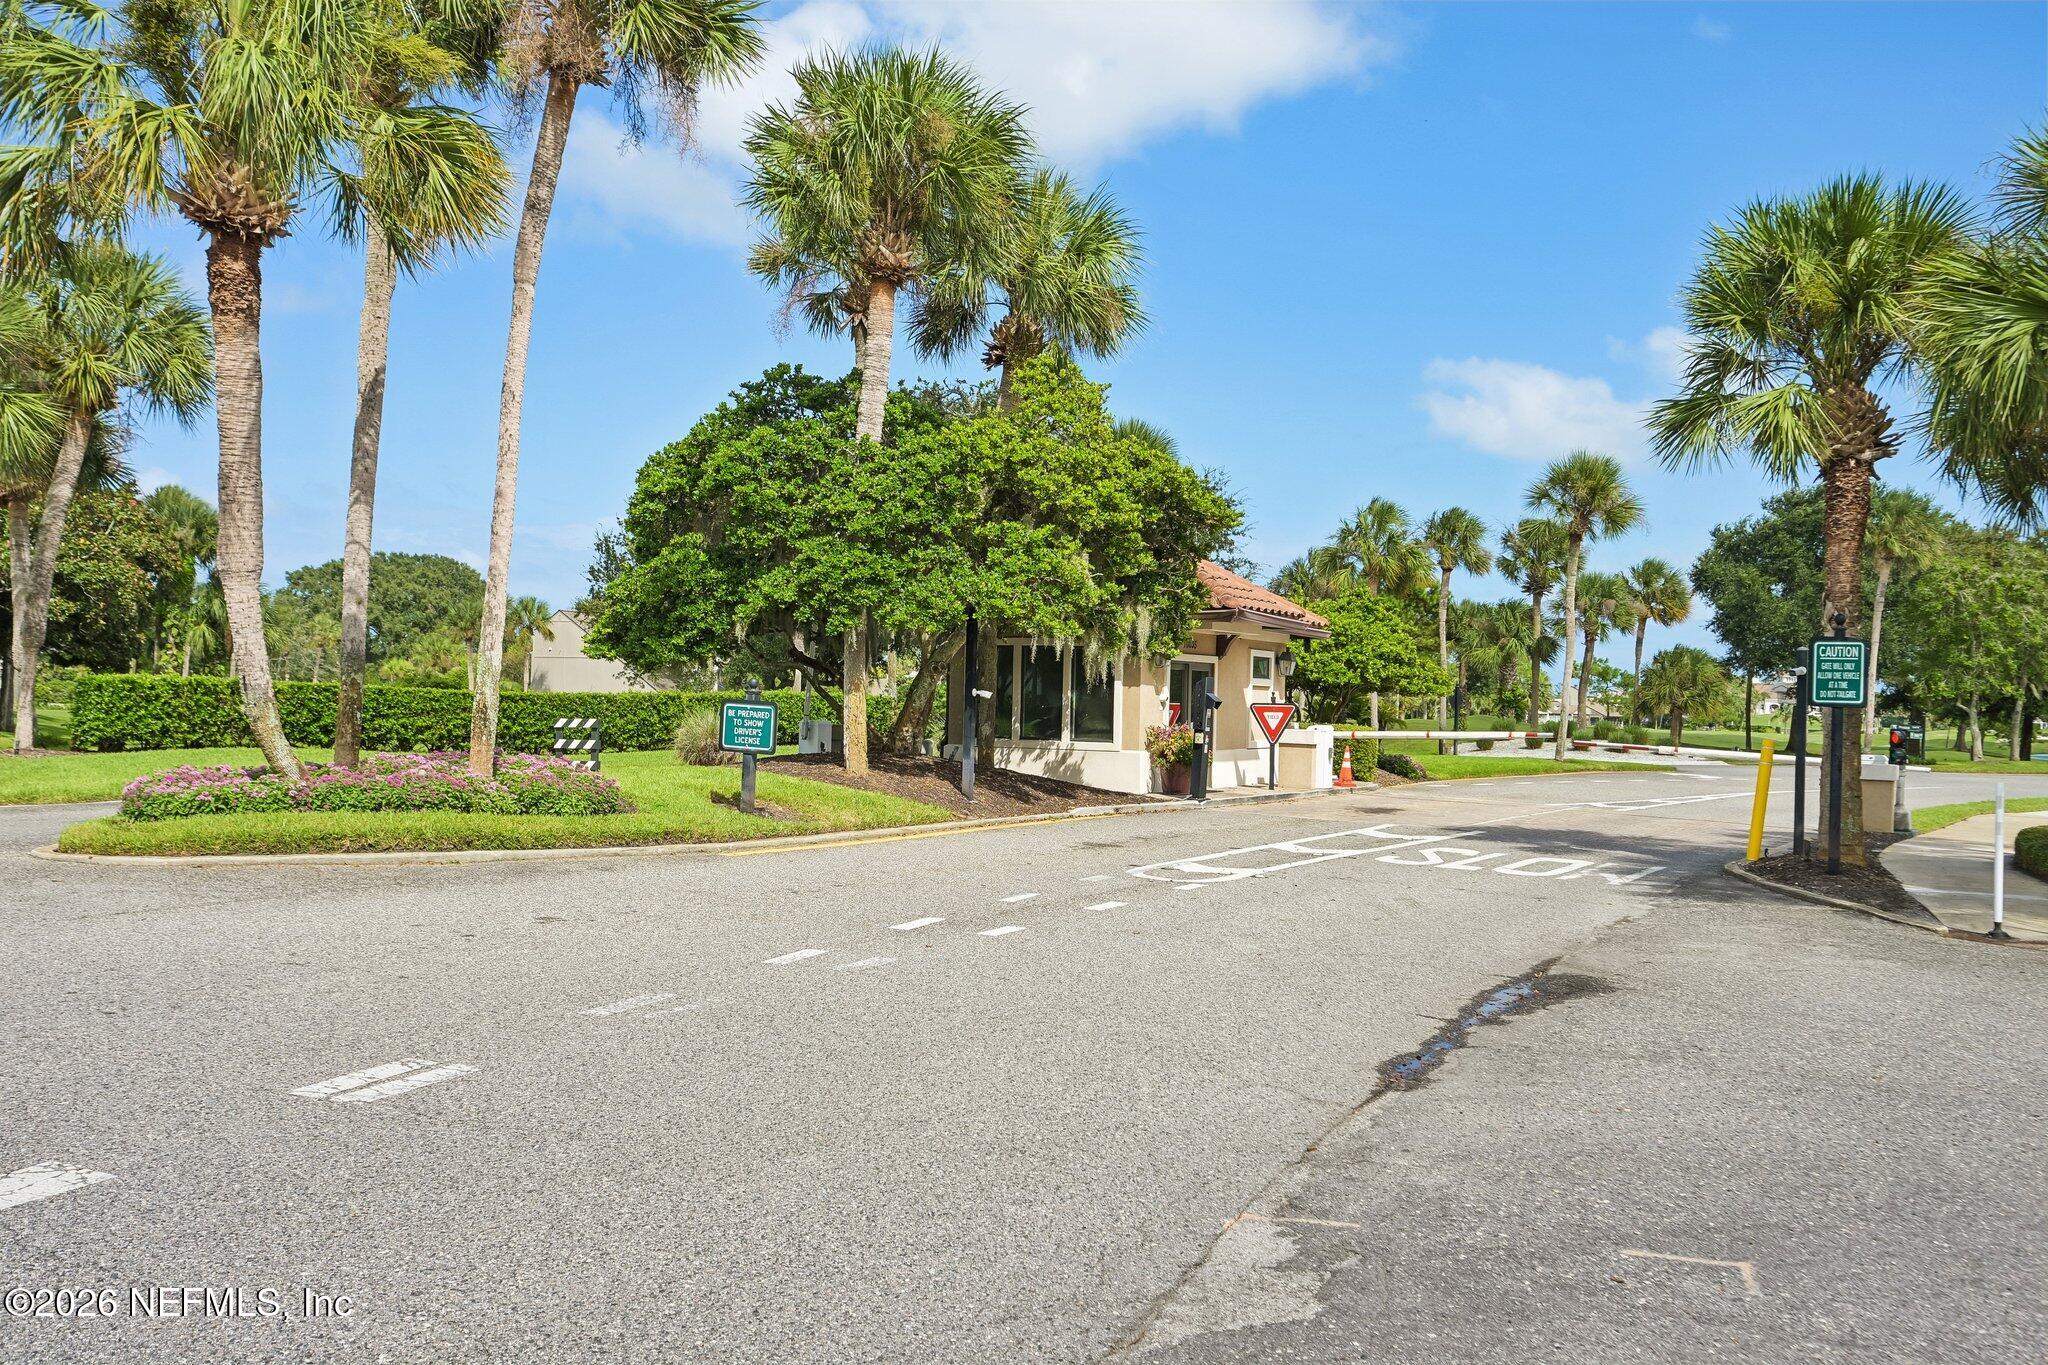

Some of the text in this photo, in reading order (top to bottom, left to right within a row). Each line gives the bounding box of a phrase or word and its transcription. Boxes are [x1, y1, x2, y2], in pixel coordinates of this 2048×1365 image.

[1820, 646, 1859, 657] CAUTION
[1821, 662, 1855, 670] GATE WILL ONLY
[1817, 671, 1860, 680] ALLOW ONE VEHICLE
[1828, 681, 1834, 689] AT
[1838, 681, 1849, 689] TIME
[1820, 690, 1857, 699] DO NOT TAILGATE
[727, 709, 770, 719] BE PREPARED
[733, 718, 764, 727] TO SHOW
[733, 727, 763, 737] DRIVER'S
[735, 736, 761, 745] LICENSE
